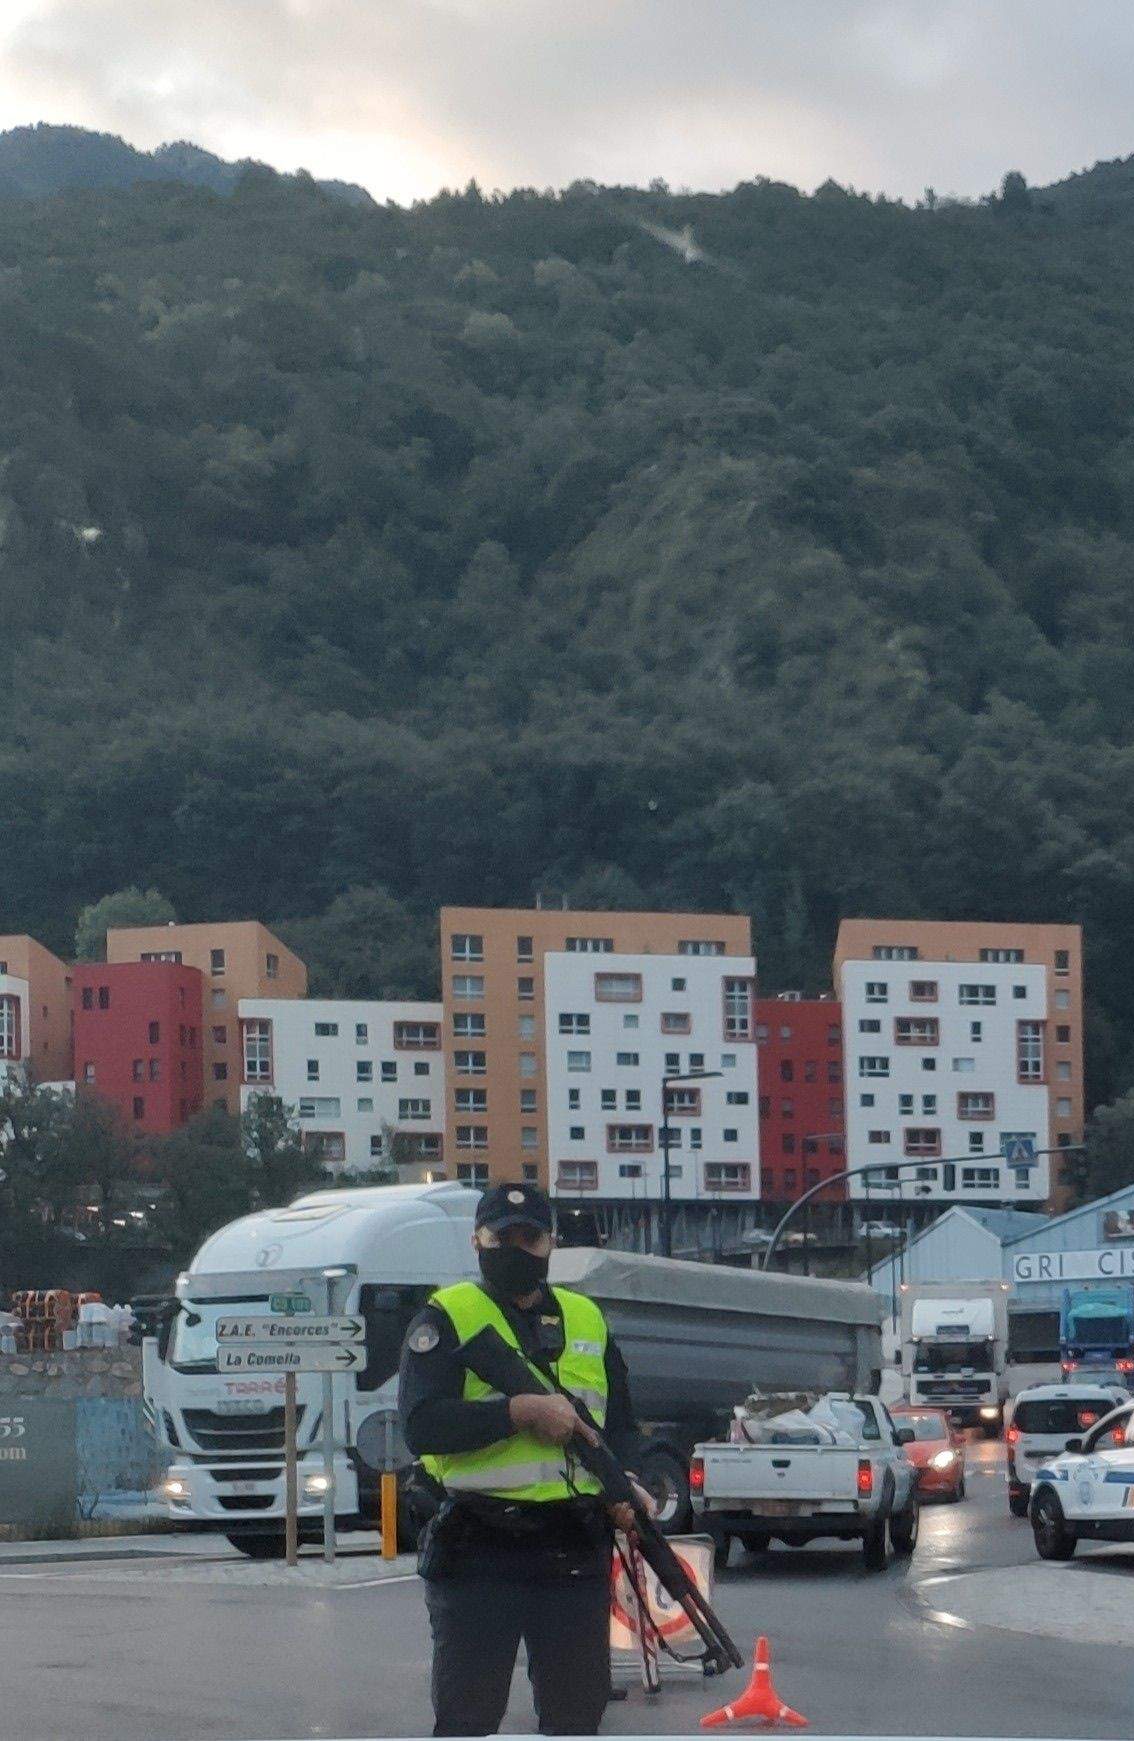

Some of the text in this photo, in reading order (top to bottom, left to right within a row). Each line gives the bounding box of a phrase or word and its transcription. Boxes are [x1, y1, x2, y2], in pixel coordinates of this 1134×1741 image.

[1015, 1254, 1064, 1279] GRI
[226, 1352, 301, 1366] La Comella
